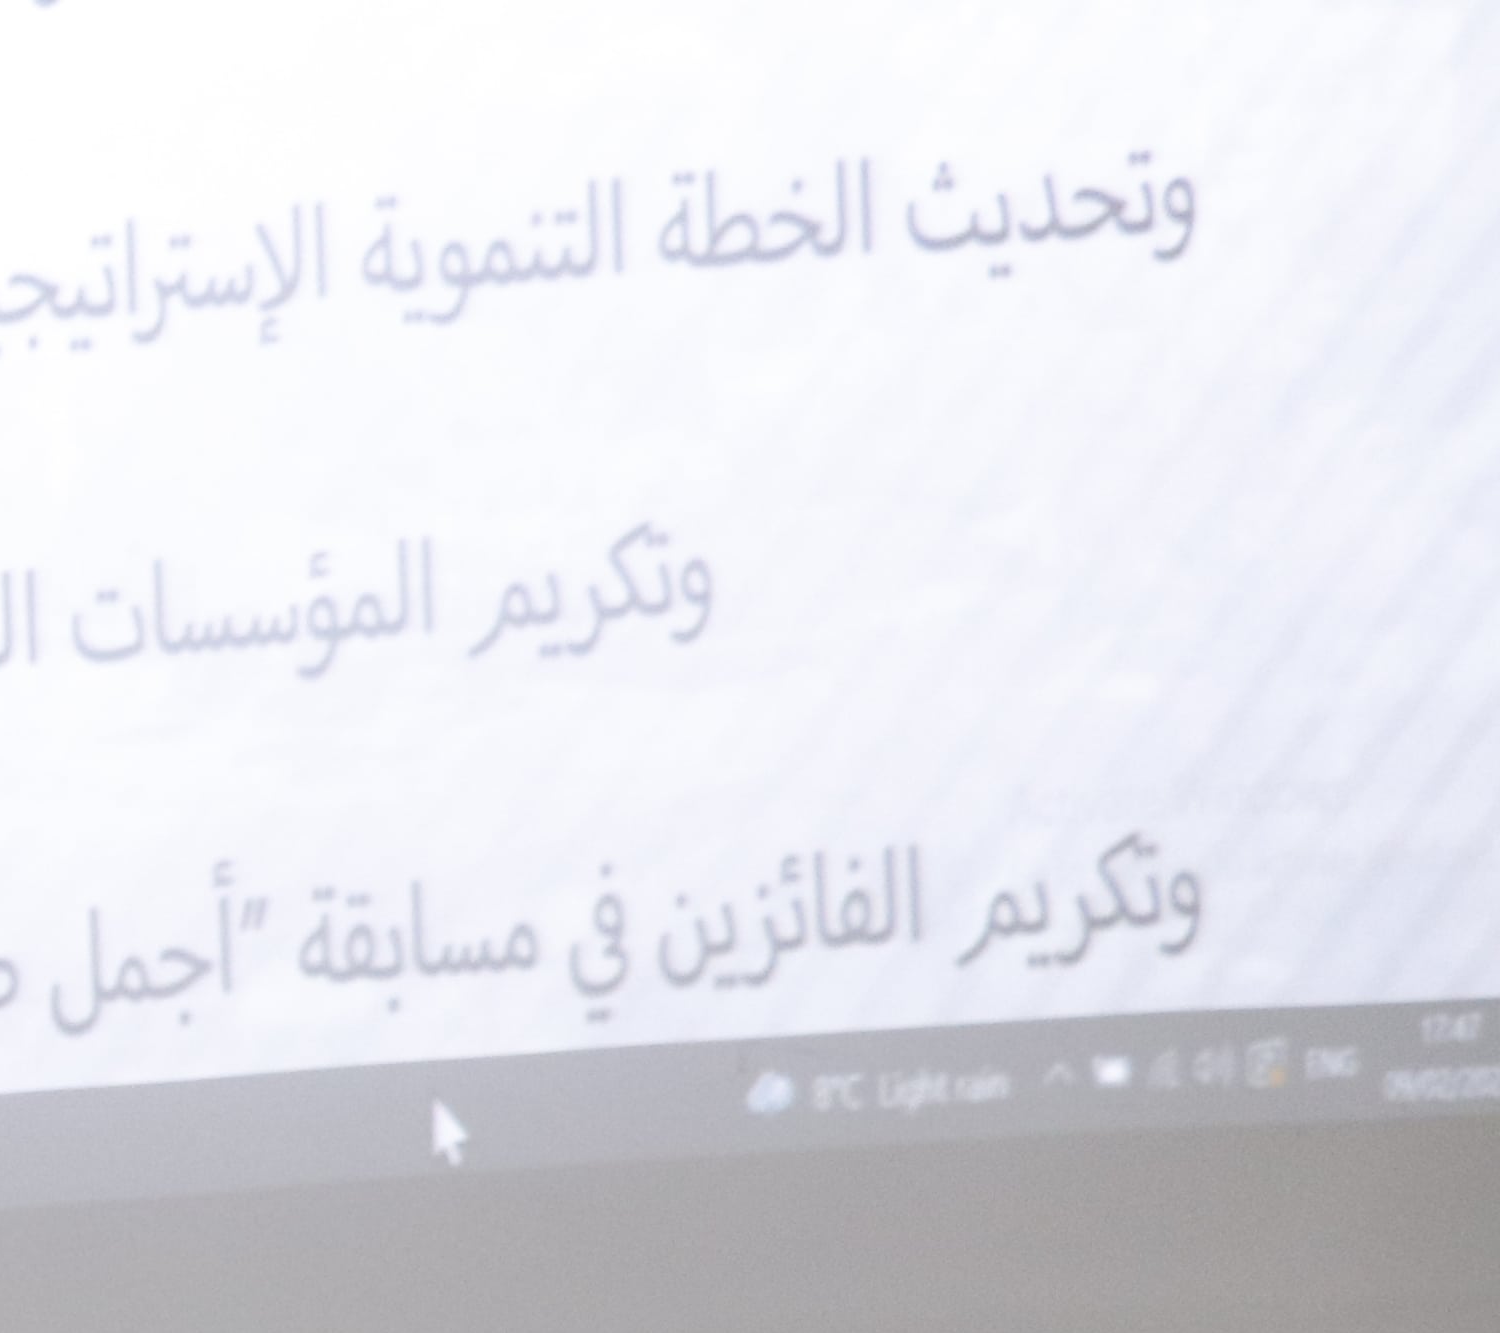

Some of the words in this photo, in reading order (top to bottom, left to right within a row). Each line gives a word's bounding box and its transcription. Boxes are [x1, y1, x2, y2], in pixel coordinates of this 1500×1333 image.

[362, 178, 624, 326] التنموية
[657, 157, 874, 268] الخطة
[905, 149, 1198, 280] وتحديث
[72, 538, 434, 680] المؤسسات
[468, 522, 714, 659] وتكريم
[298, 881, 541, 1014] مسابقة
[568, 863, 630, 1024] في
[657, 843, 924, 1024] الفائزين
[954, 830, 1205, 970] وتكريم
